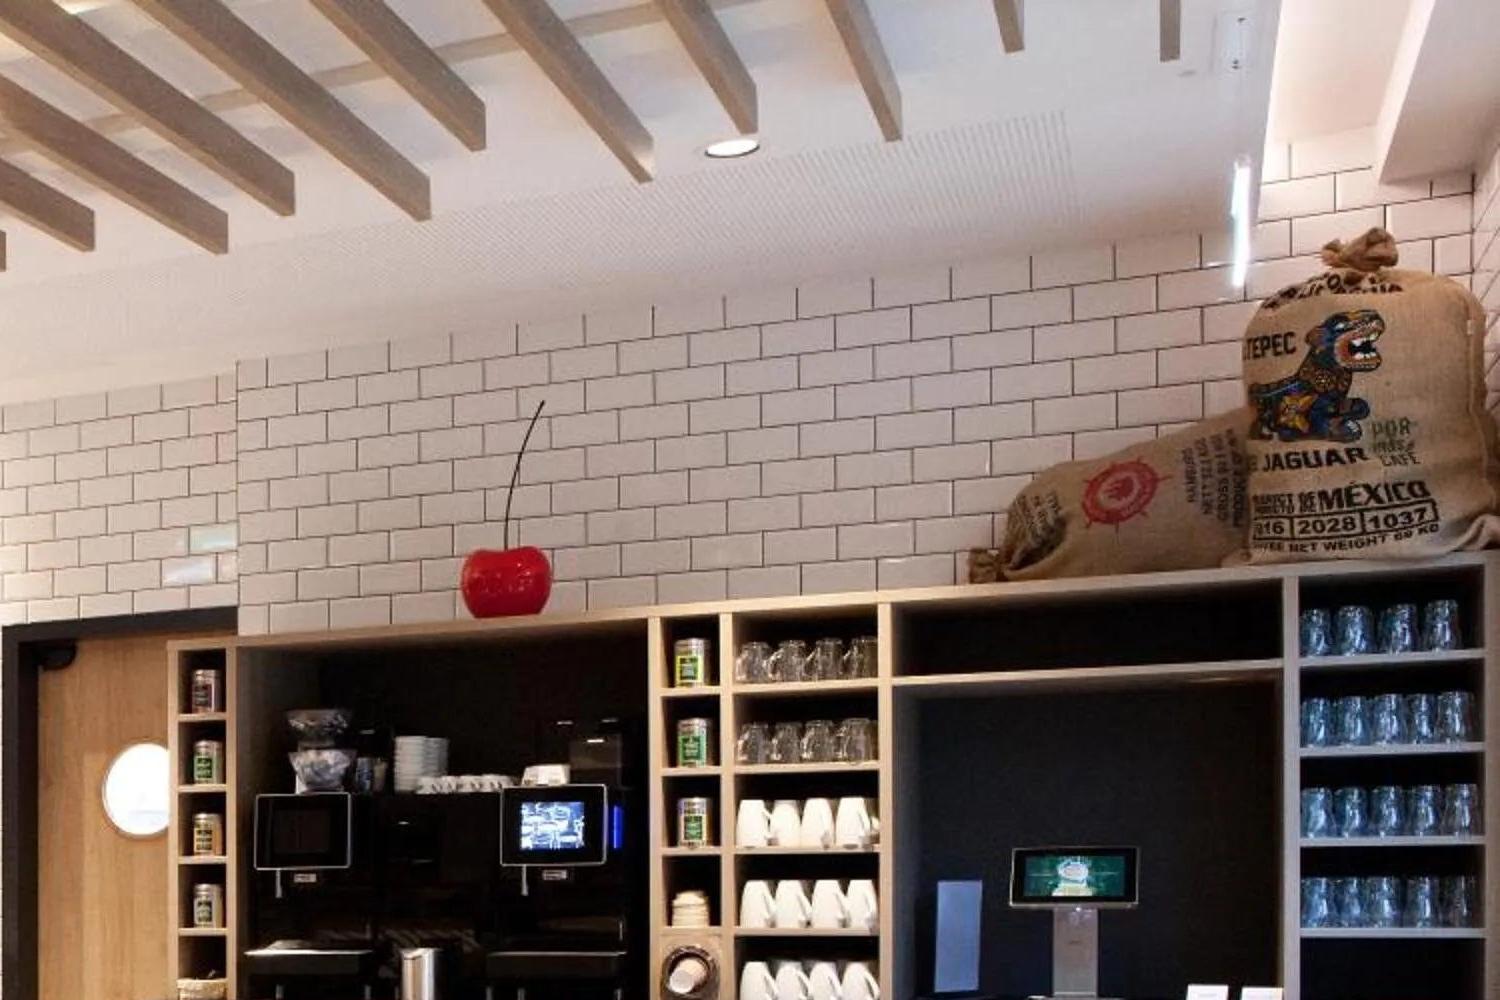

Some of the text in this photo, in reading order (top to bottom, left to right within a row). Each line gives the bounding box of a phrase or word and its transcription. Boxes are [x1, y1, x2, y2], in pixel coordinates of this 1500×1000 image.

[1242, 331, 1297, 361] TEPEC
[1262, 447, 1369, 473] JAGUAR
[1299, 517, 1356, 535] 2028
[1368, 508, 1427, 529] 1037
[1323, 535, 1387, 552] WEIGHT
